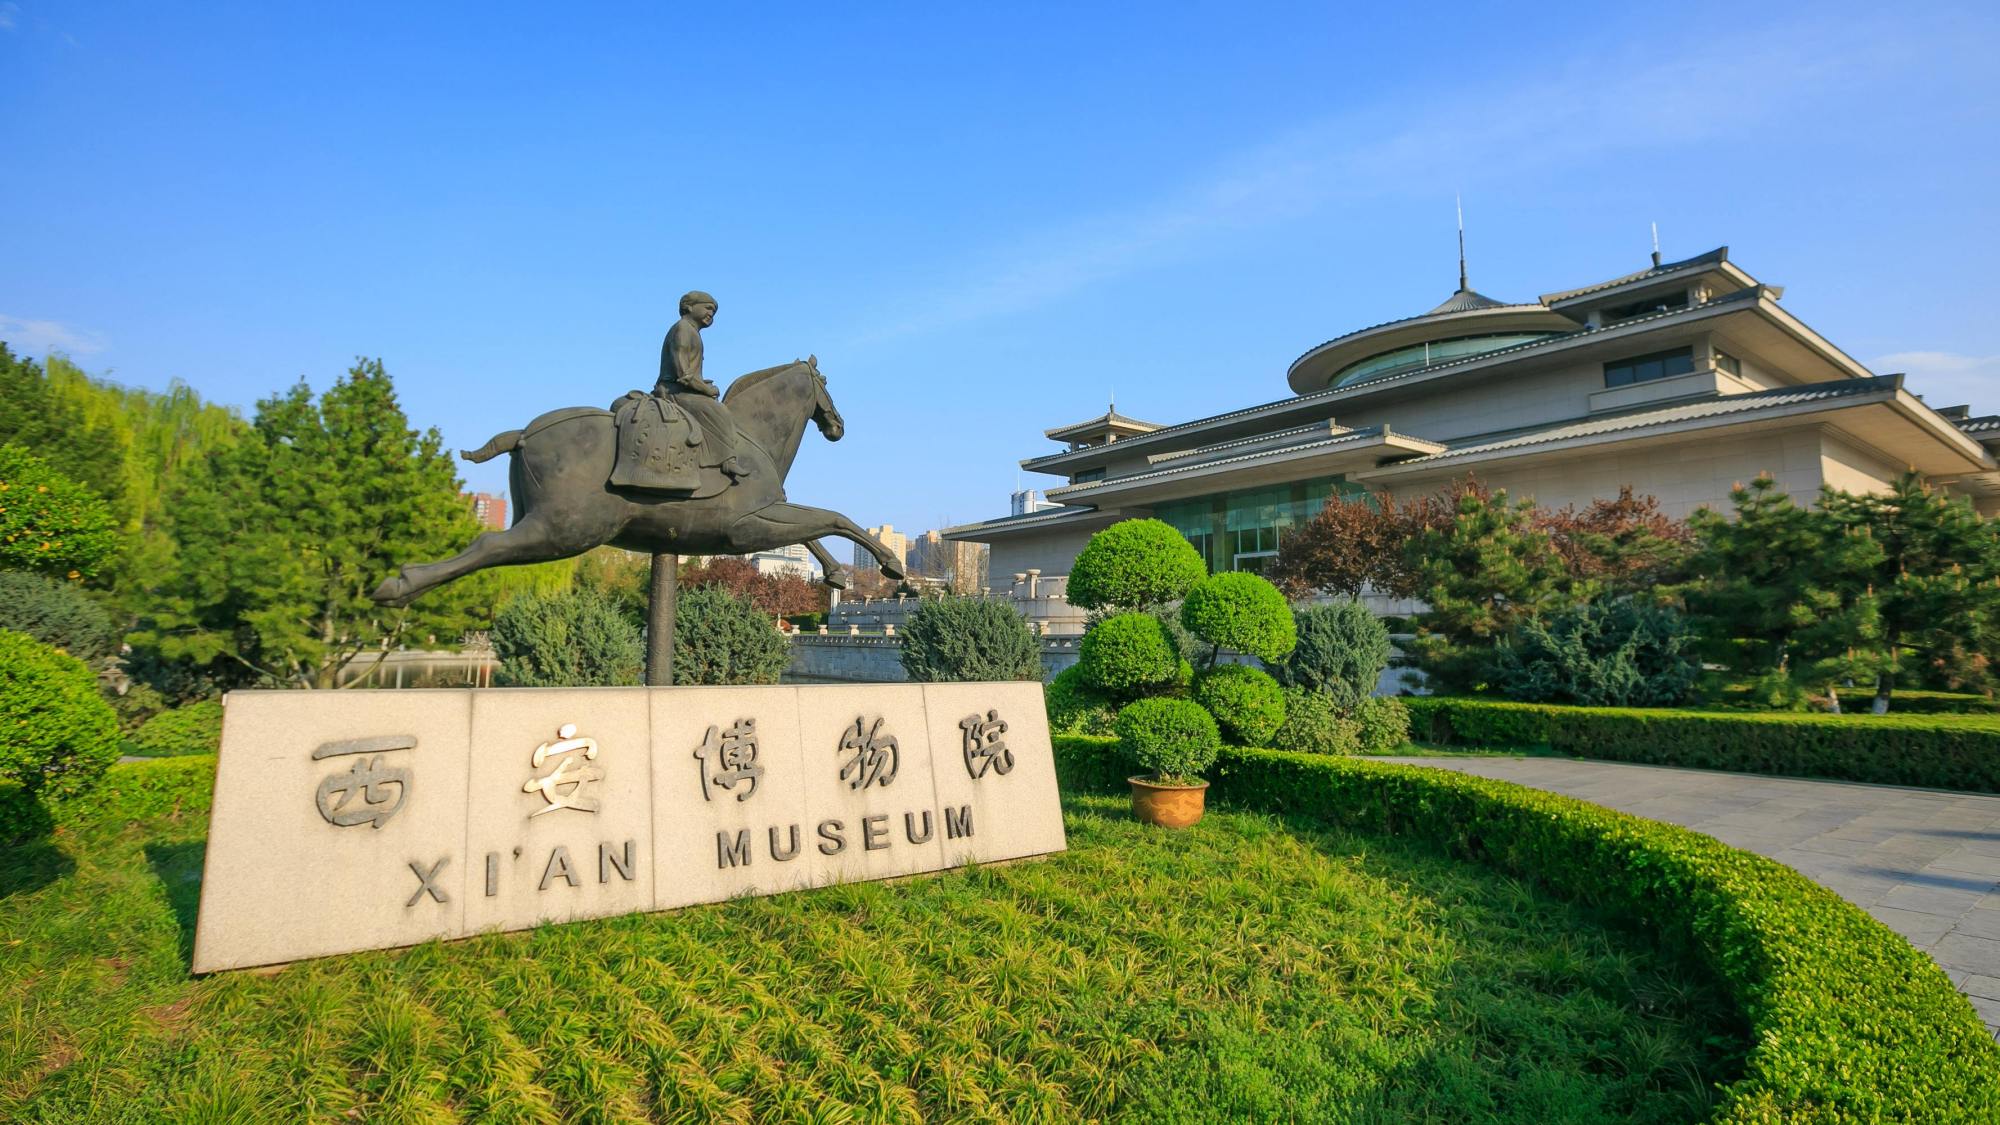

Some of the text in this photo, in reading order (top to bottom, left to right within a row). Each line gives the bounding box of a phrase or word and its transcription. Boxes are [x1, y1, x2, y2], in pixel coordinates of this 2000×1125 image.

[312, 709, 1015, 829] 西安博物院
[406, 804, 975, 907] XI'AN MUSEUM
